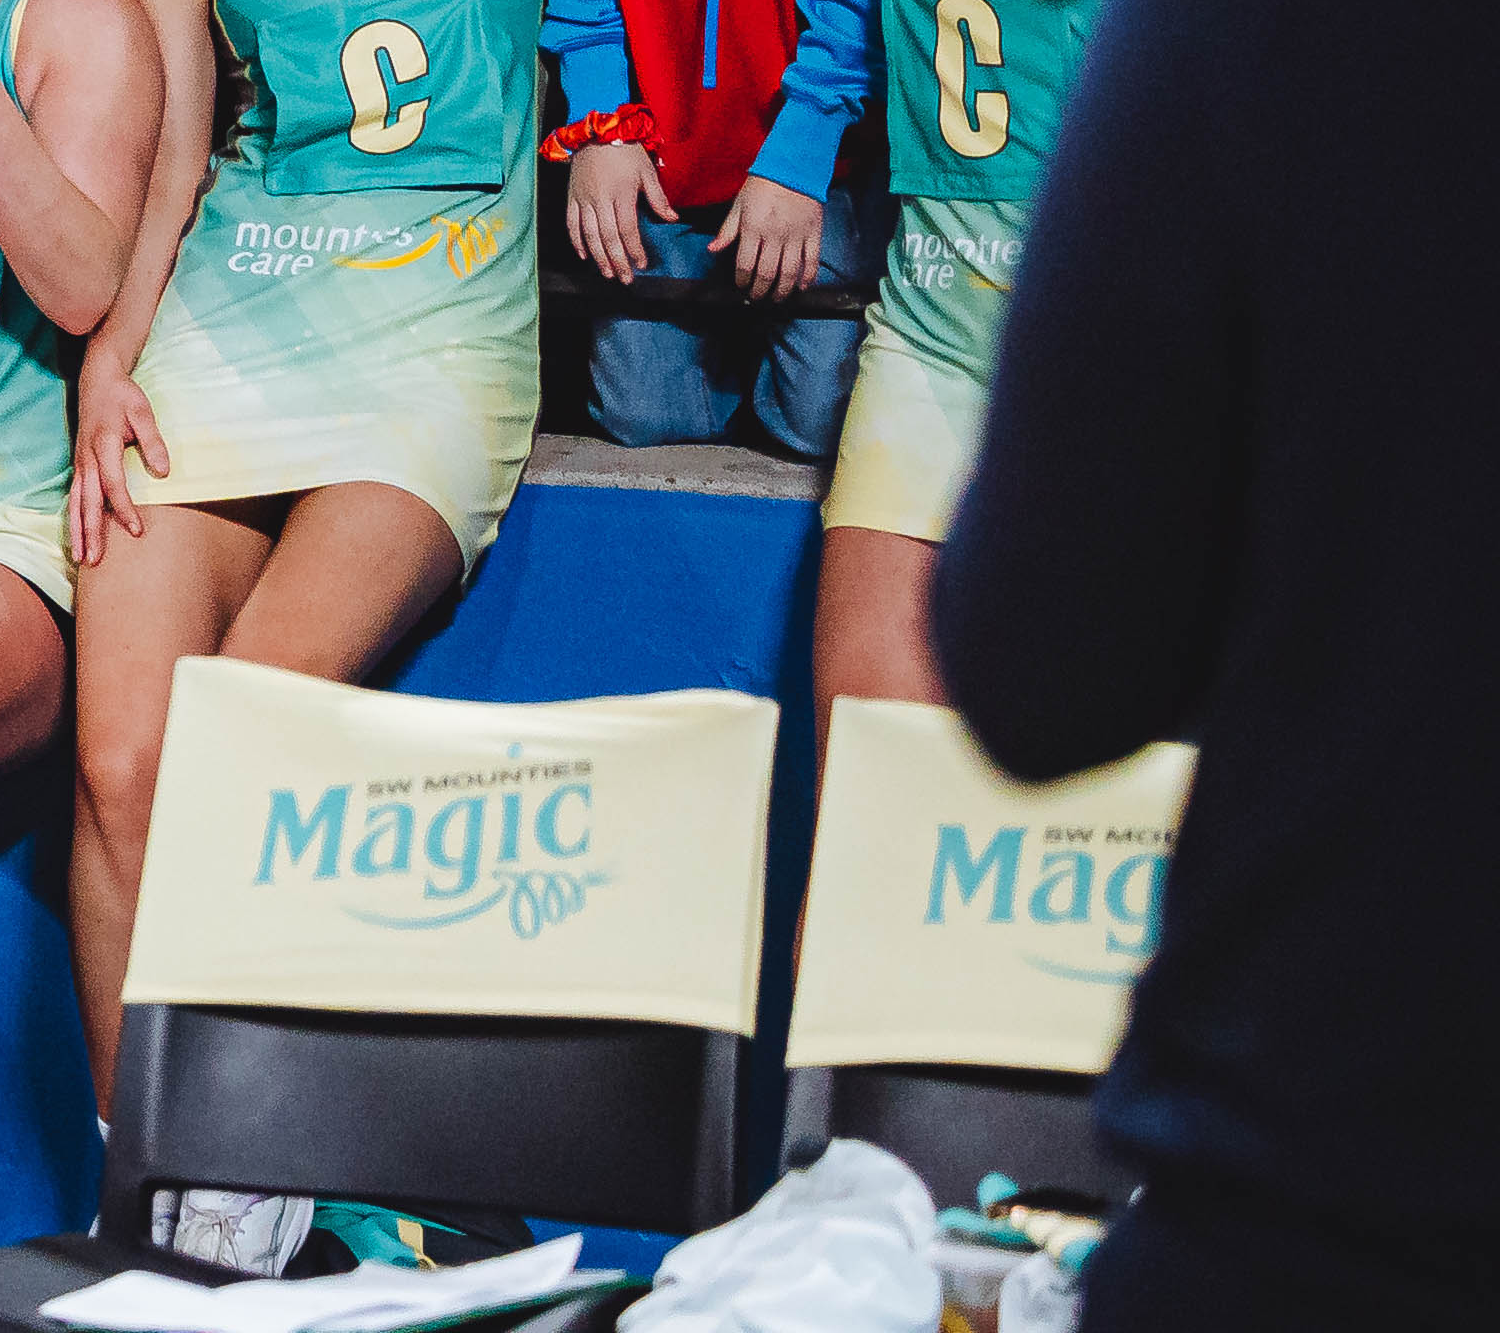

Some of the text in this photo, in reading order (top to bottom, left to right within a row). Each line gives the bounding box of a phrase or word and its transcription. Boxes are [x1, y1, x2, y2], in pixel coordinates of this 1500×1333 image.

[340, 18, 430, 155] C
[228, 250, 314, 276] care
[366, 760, 594, 798] SW MOUNTIES
[253, 783, 593, 902] Magic
[1042, 826, 1094, 846] SW
[924, 823, 1172, 958] Mag
